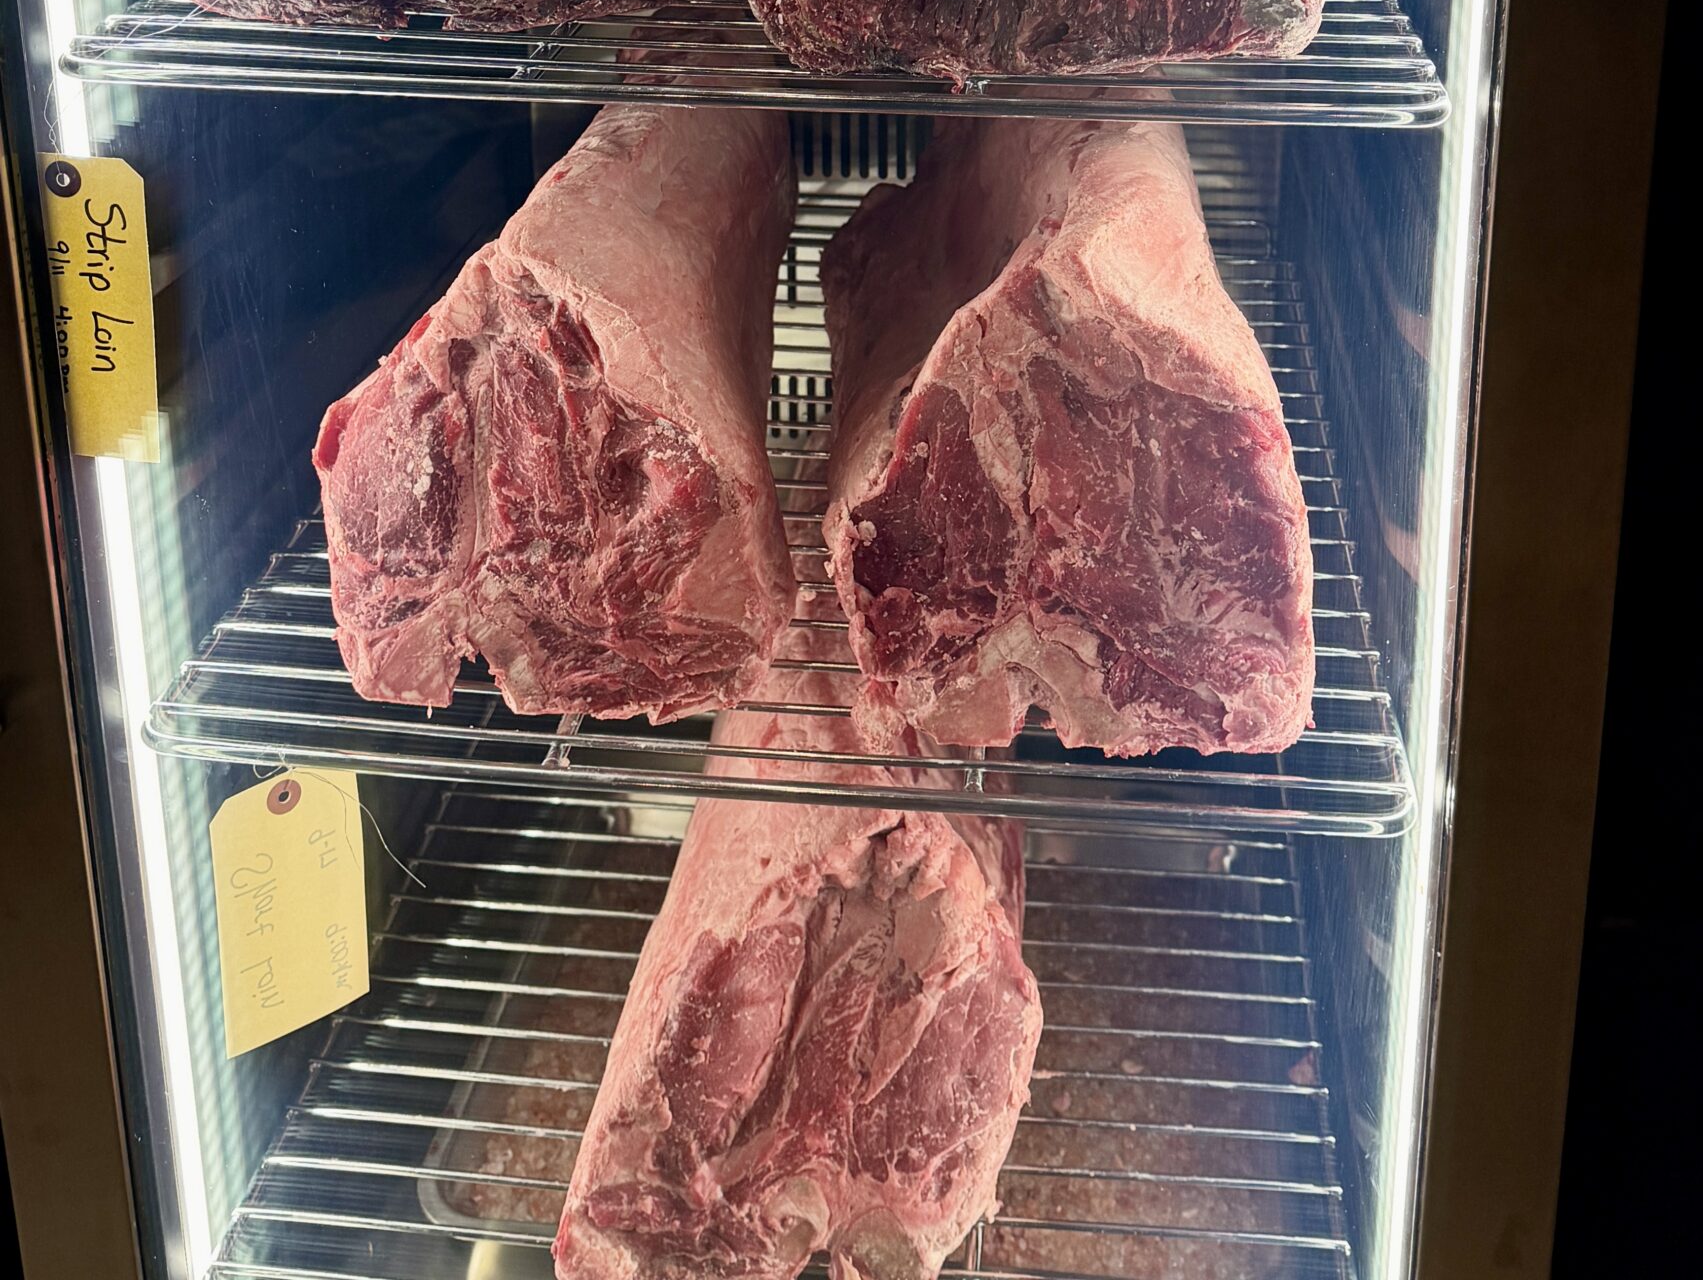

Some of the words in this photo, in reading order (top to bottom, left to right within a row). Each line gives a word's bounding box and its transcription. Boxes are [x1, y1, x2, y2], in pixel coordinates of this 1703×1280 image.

[48, 240, 71, 276] 9/11
[79, 198, 127, 293] Strip
[91, 310, 135, 373] Loin
